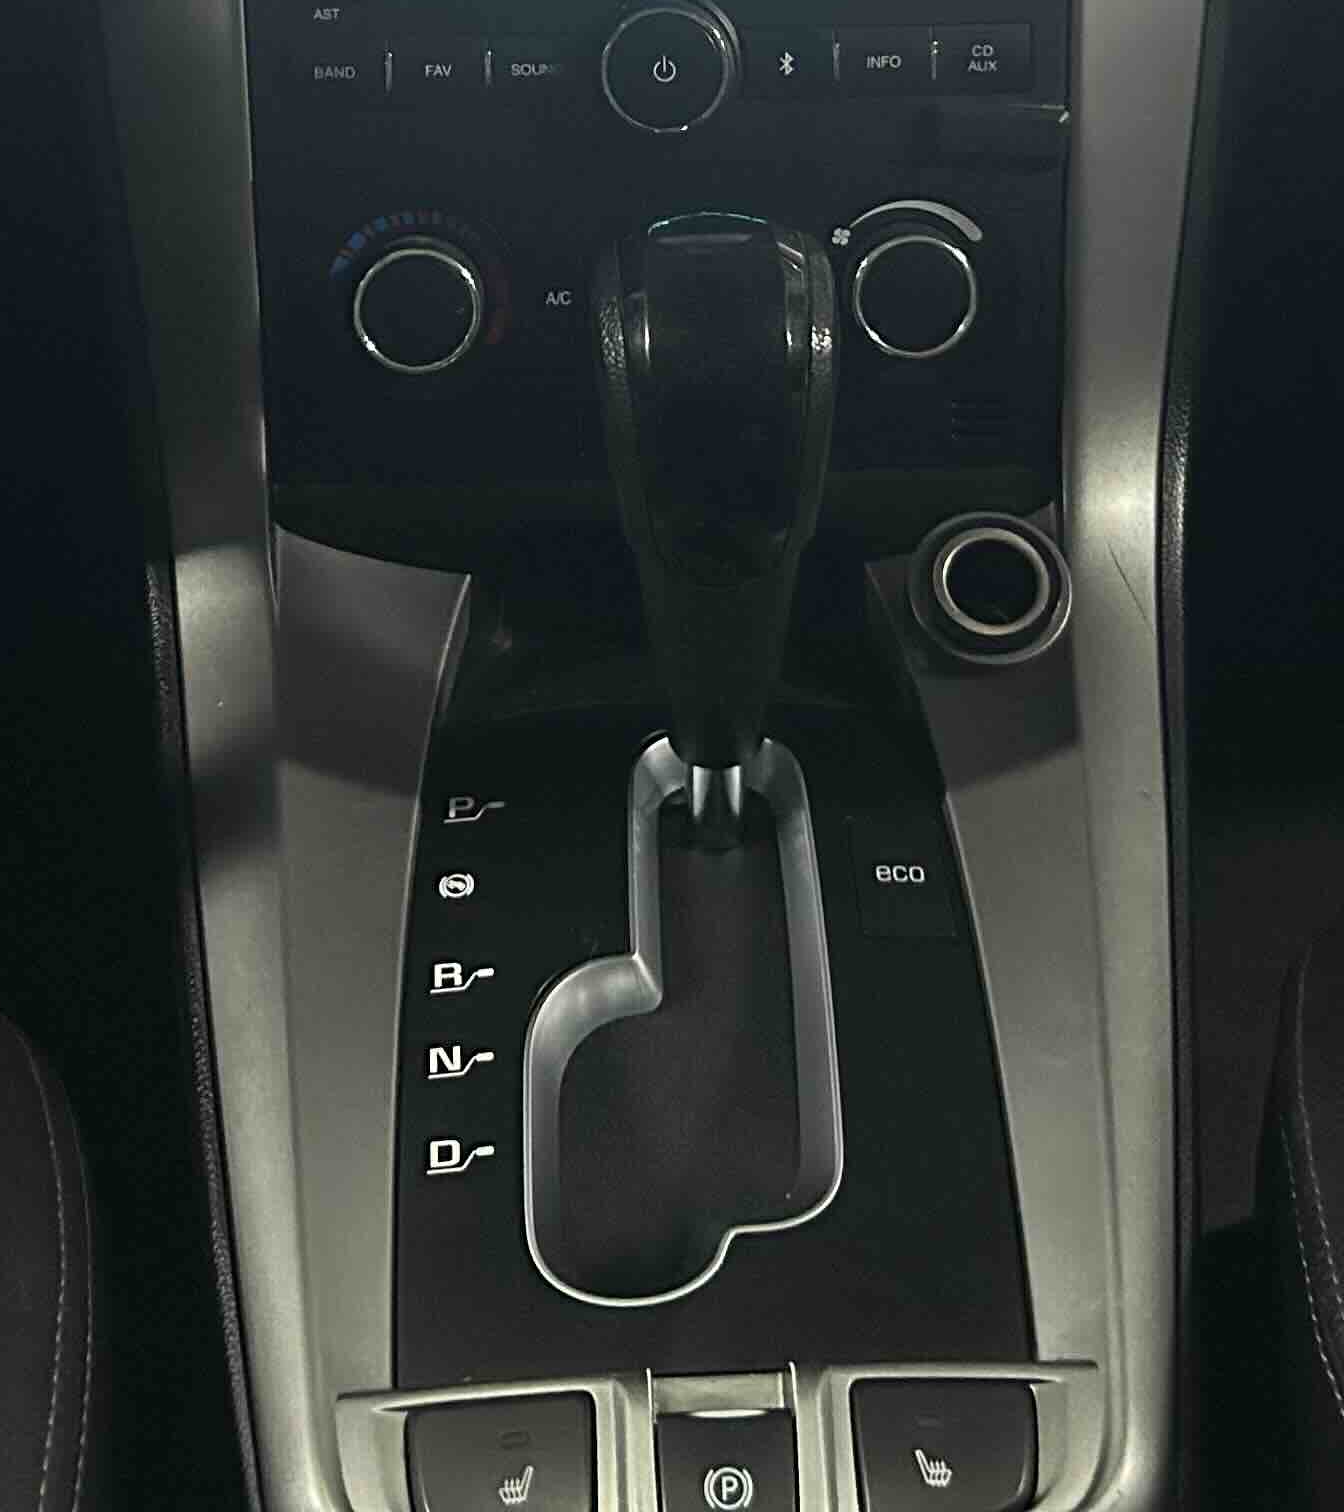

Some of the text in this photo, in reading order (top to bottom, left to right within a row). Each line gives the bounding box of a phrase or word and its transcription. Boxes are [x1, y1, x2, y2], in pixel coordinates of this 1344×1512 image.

[313, 7, 340, 21] AST
[971, 44, 994, 58] CD
[866, 55, 902, 70] INFO
[968, 60, 998, 72] AUX
[313, 65, 356, 80] BAND
[425, 64, 452, 77] FAV
[545, 290, 572, 305] A/C
[448, 797, 476, 819] P
[875, 865, 925, 883] eco
[433, 962, 464, 988] R
[429, 1045, 462, 1073] N
[429, 1140, 462, 1169] D
